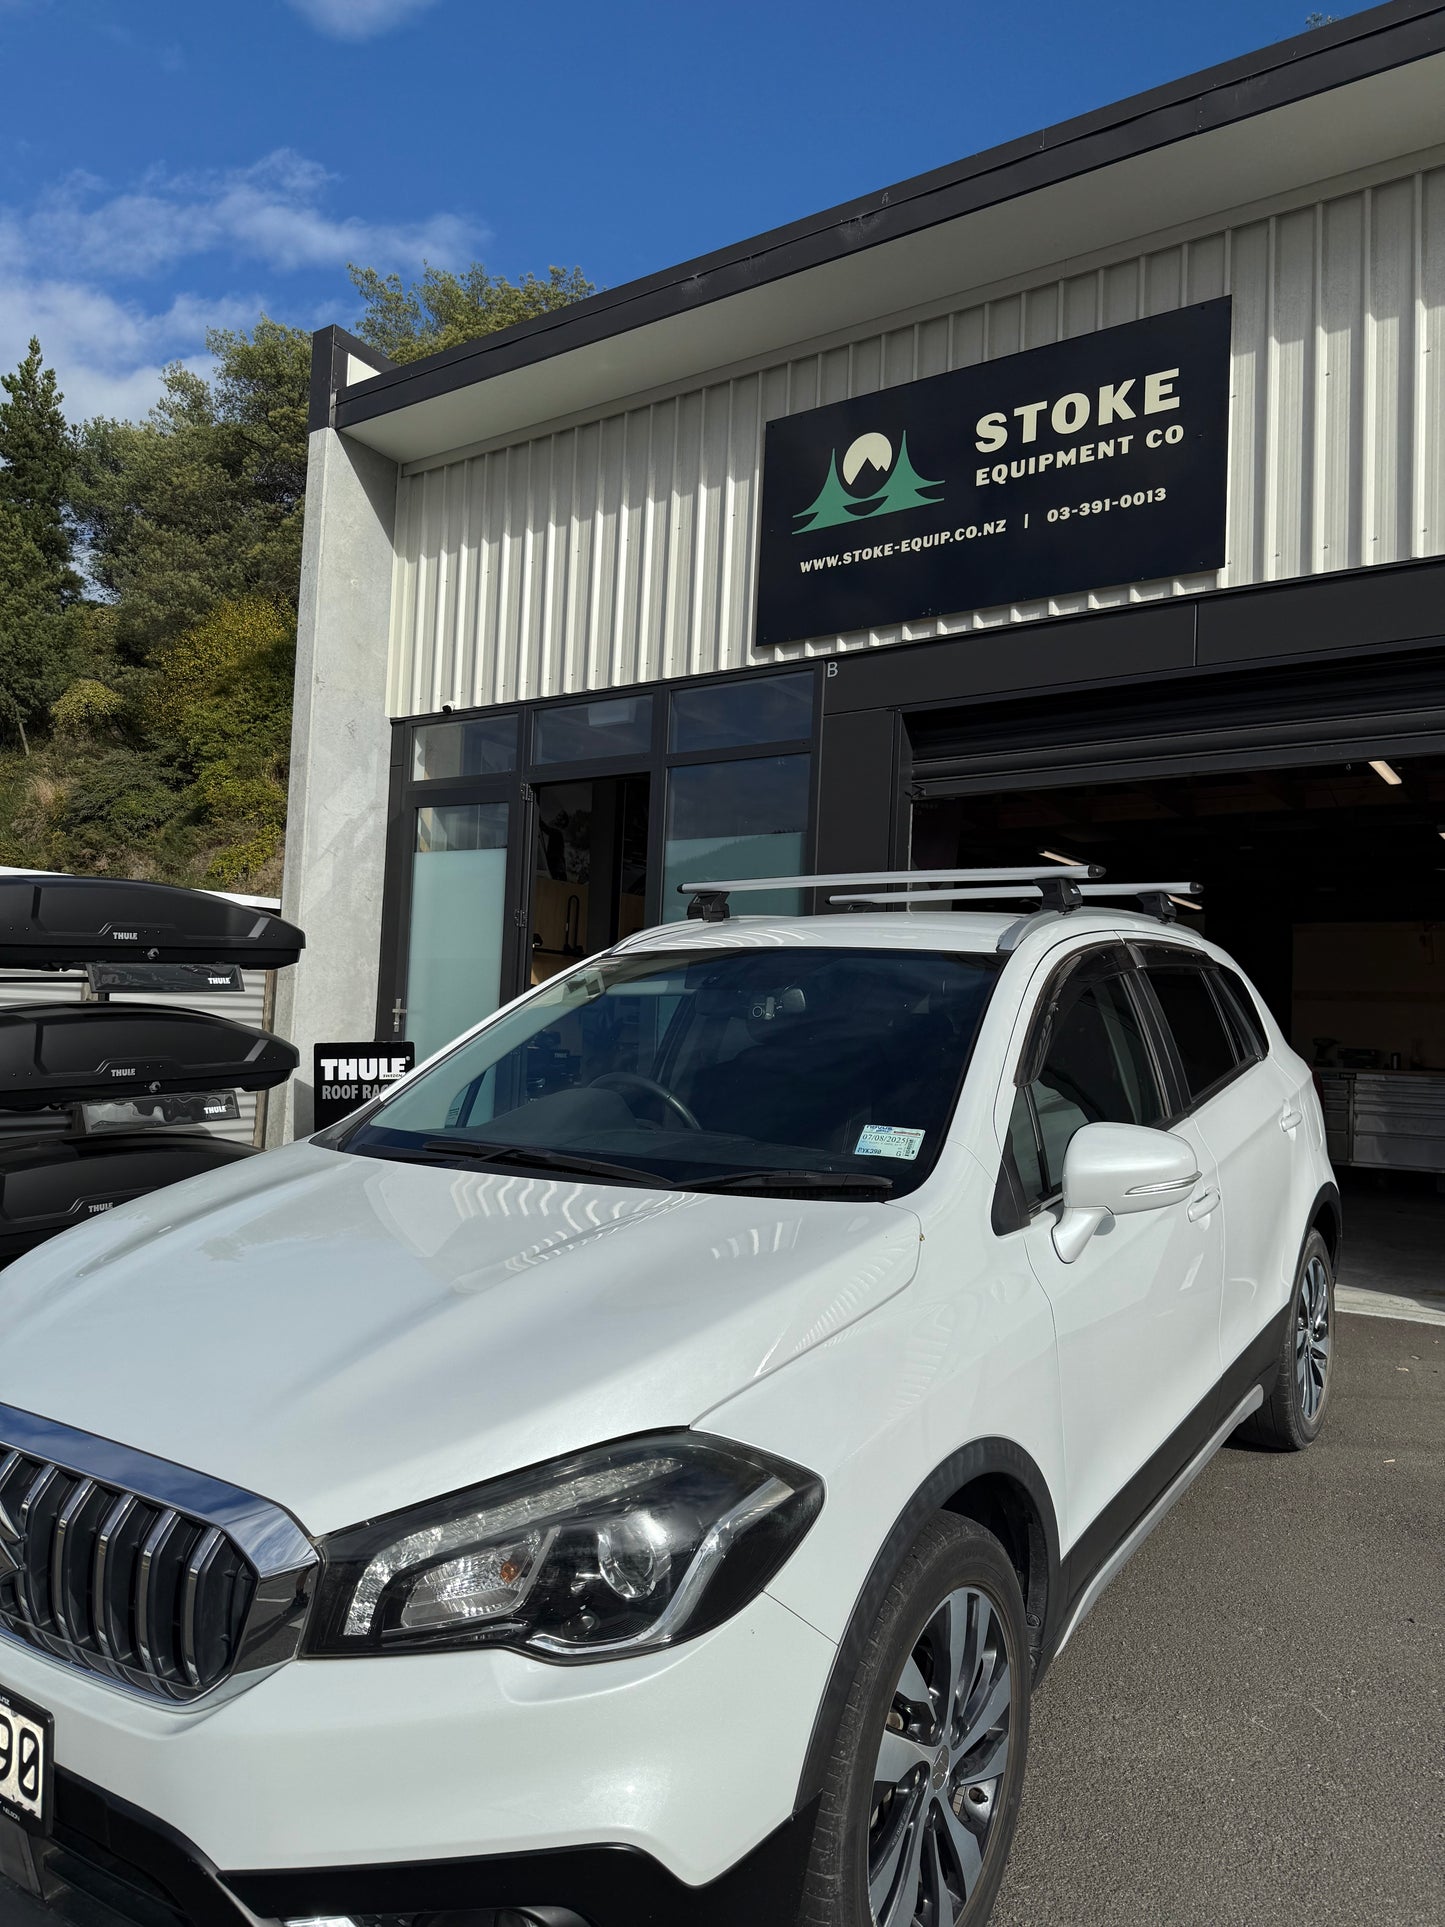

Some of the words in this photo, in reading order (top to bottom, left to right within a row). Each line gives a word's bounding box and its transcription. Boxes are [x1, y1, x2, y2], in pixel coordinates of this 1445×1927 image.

[975, 368, 1180, 453] STOKE
[976, 435, 1134, 487] EQUIPMENT
[1146, 425, 1184, 449] CO
[800, 519, 1007, 573] WWW.STOKE-EQUIP.CO.NZ
[1047, 487, 1167, 523] 03-391-0013
[827, 661, 838, 678] B
[112, 931, 138, 940] THULE
[207, 977, 231, 985] THULE
[110, 1068, 136, 1077] THULE
[320, 1057, 407, 1081] THULE
[322, 1084, 359, 1100] ROOF
[203, 1105, 227, 1114] THULE
[862, 1134, 906, 1144] 07/08/2025
[88, 1202, 114, 1213] THULE
